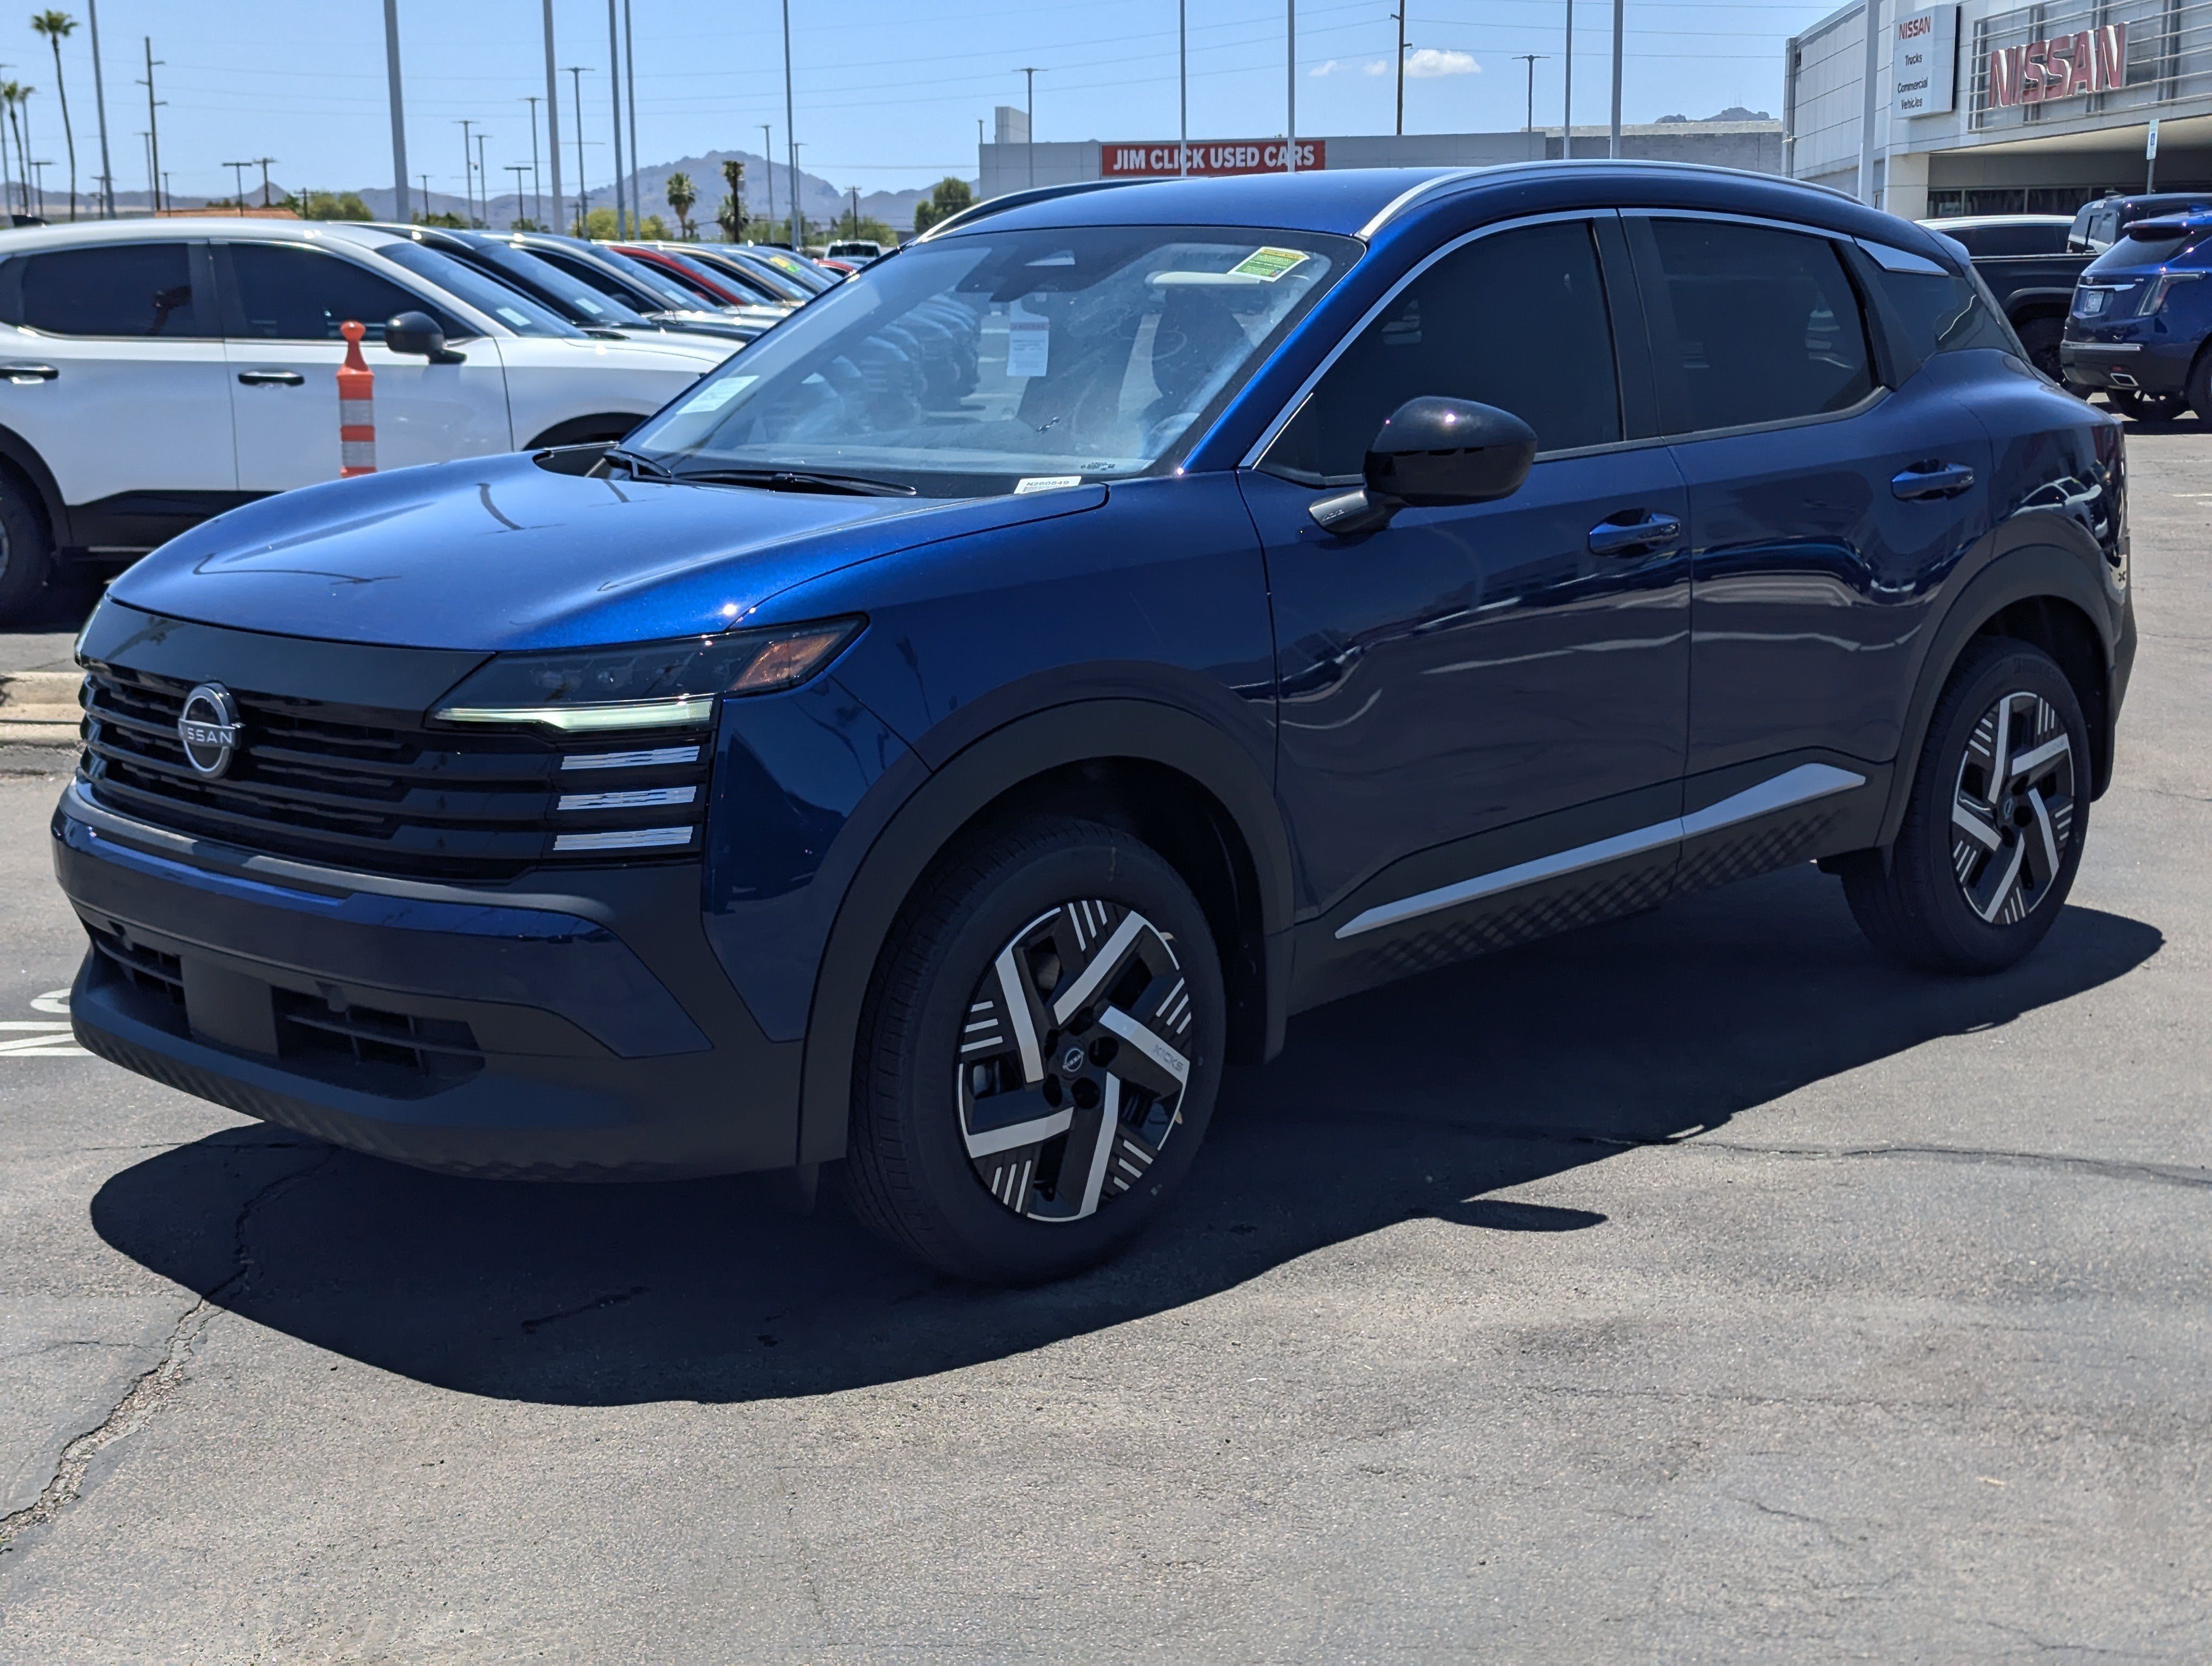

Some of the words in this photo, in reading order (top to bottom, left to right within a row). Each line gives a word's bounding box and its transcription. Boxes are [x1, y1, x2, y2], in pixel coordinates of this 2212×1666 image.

[1899, 16, 1931, 40] NISSAN
[1905, 53, 1922, 66] Trucks
[1989, 22, 2127, 109] NISSAN
[1898, 76, 1928, 95] Commercial
[1901, 97, 1923, 110] Vehicles
[1113, 149, 1146, 170] JIM
[1150, 148, 1205, 170] CLICK
[1210, 147, 1259, 168] USED
[1264, 145, 1315, 167] CARS
[181, 726, 233, 744] SSAN
